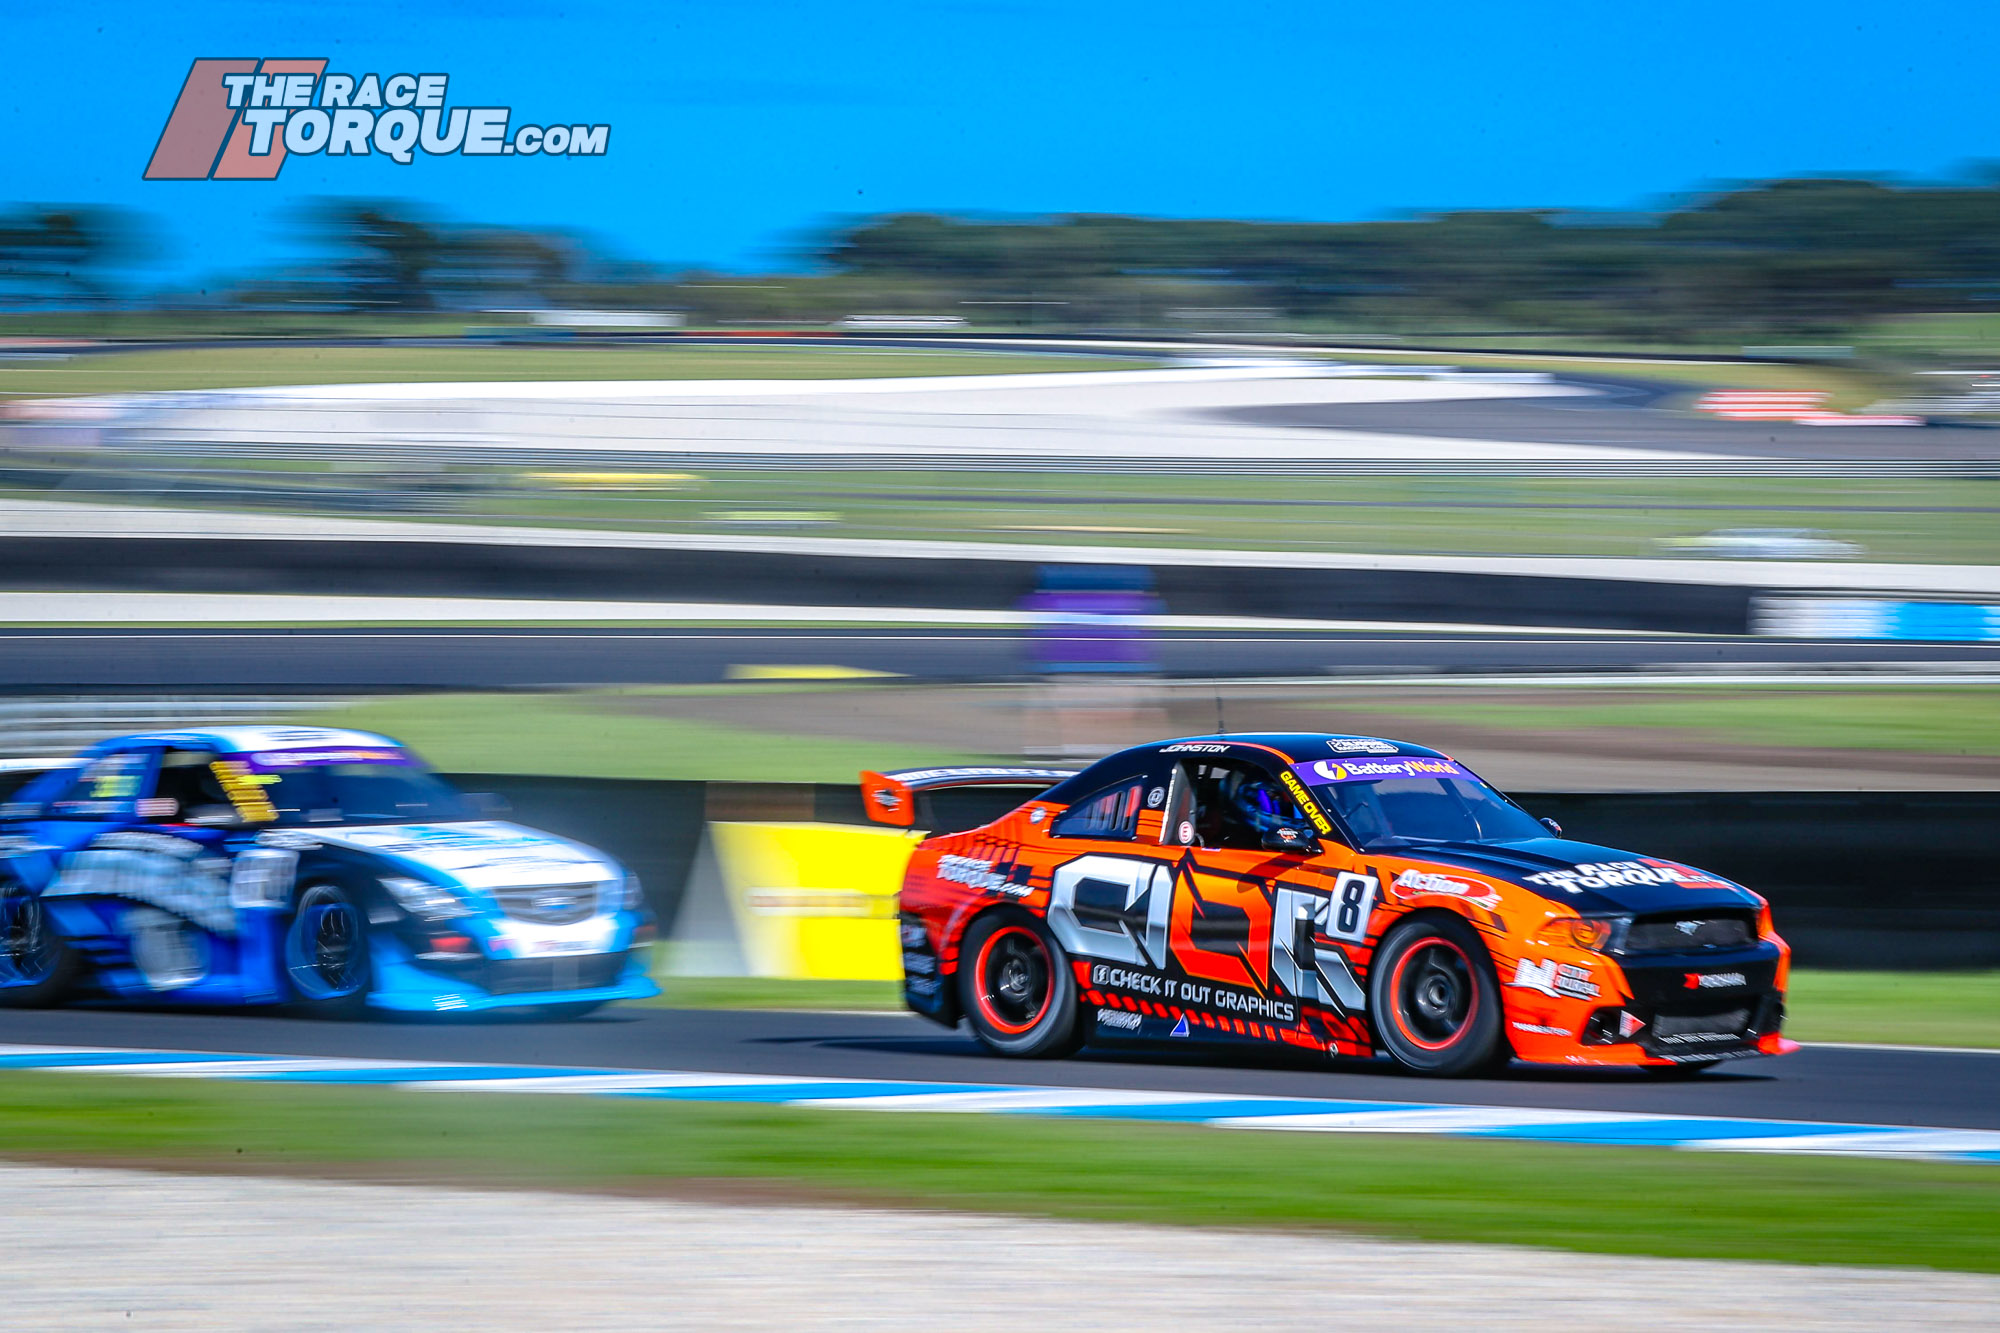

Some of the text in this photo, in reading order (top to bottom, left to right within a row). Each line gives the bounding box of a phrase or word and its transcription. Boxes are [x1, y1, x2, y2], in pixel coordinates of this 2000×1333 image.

[1159, 744, 1231, 753] JOHNSTON
[1280, 770, 1309, 805] GAME
[1303, 802, 1333, 835] OVER
[1521, 861, 1646, 886] THE RACE
[1338, 879, 1365, 933] 8
[1110, 968, 1294, 1022] CHECK IT OUT GRAPHICS
